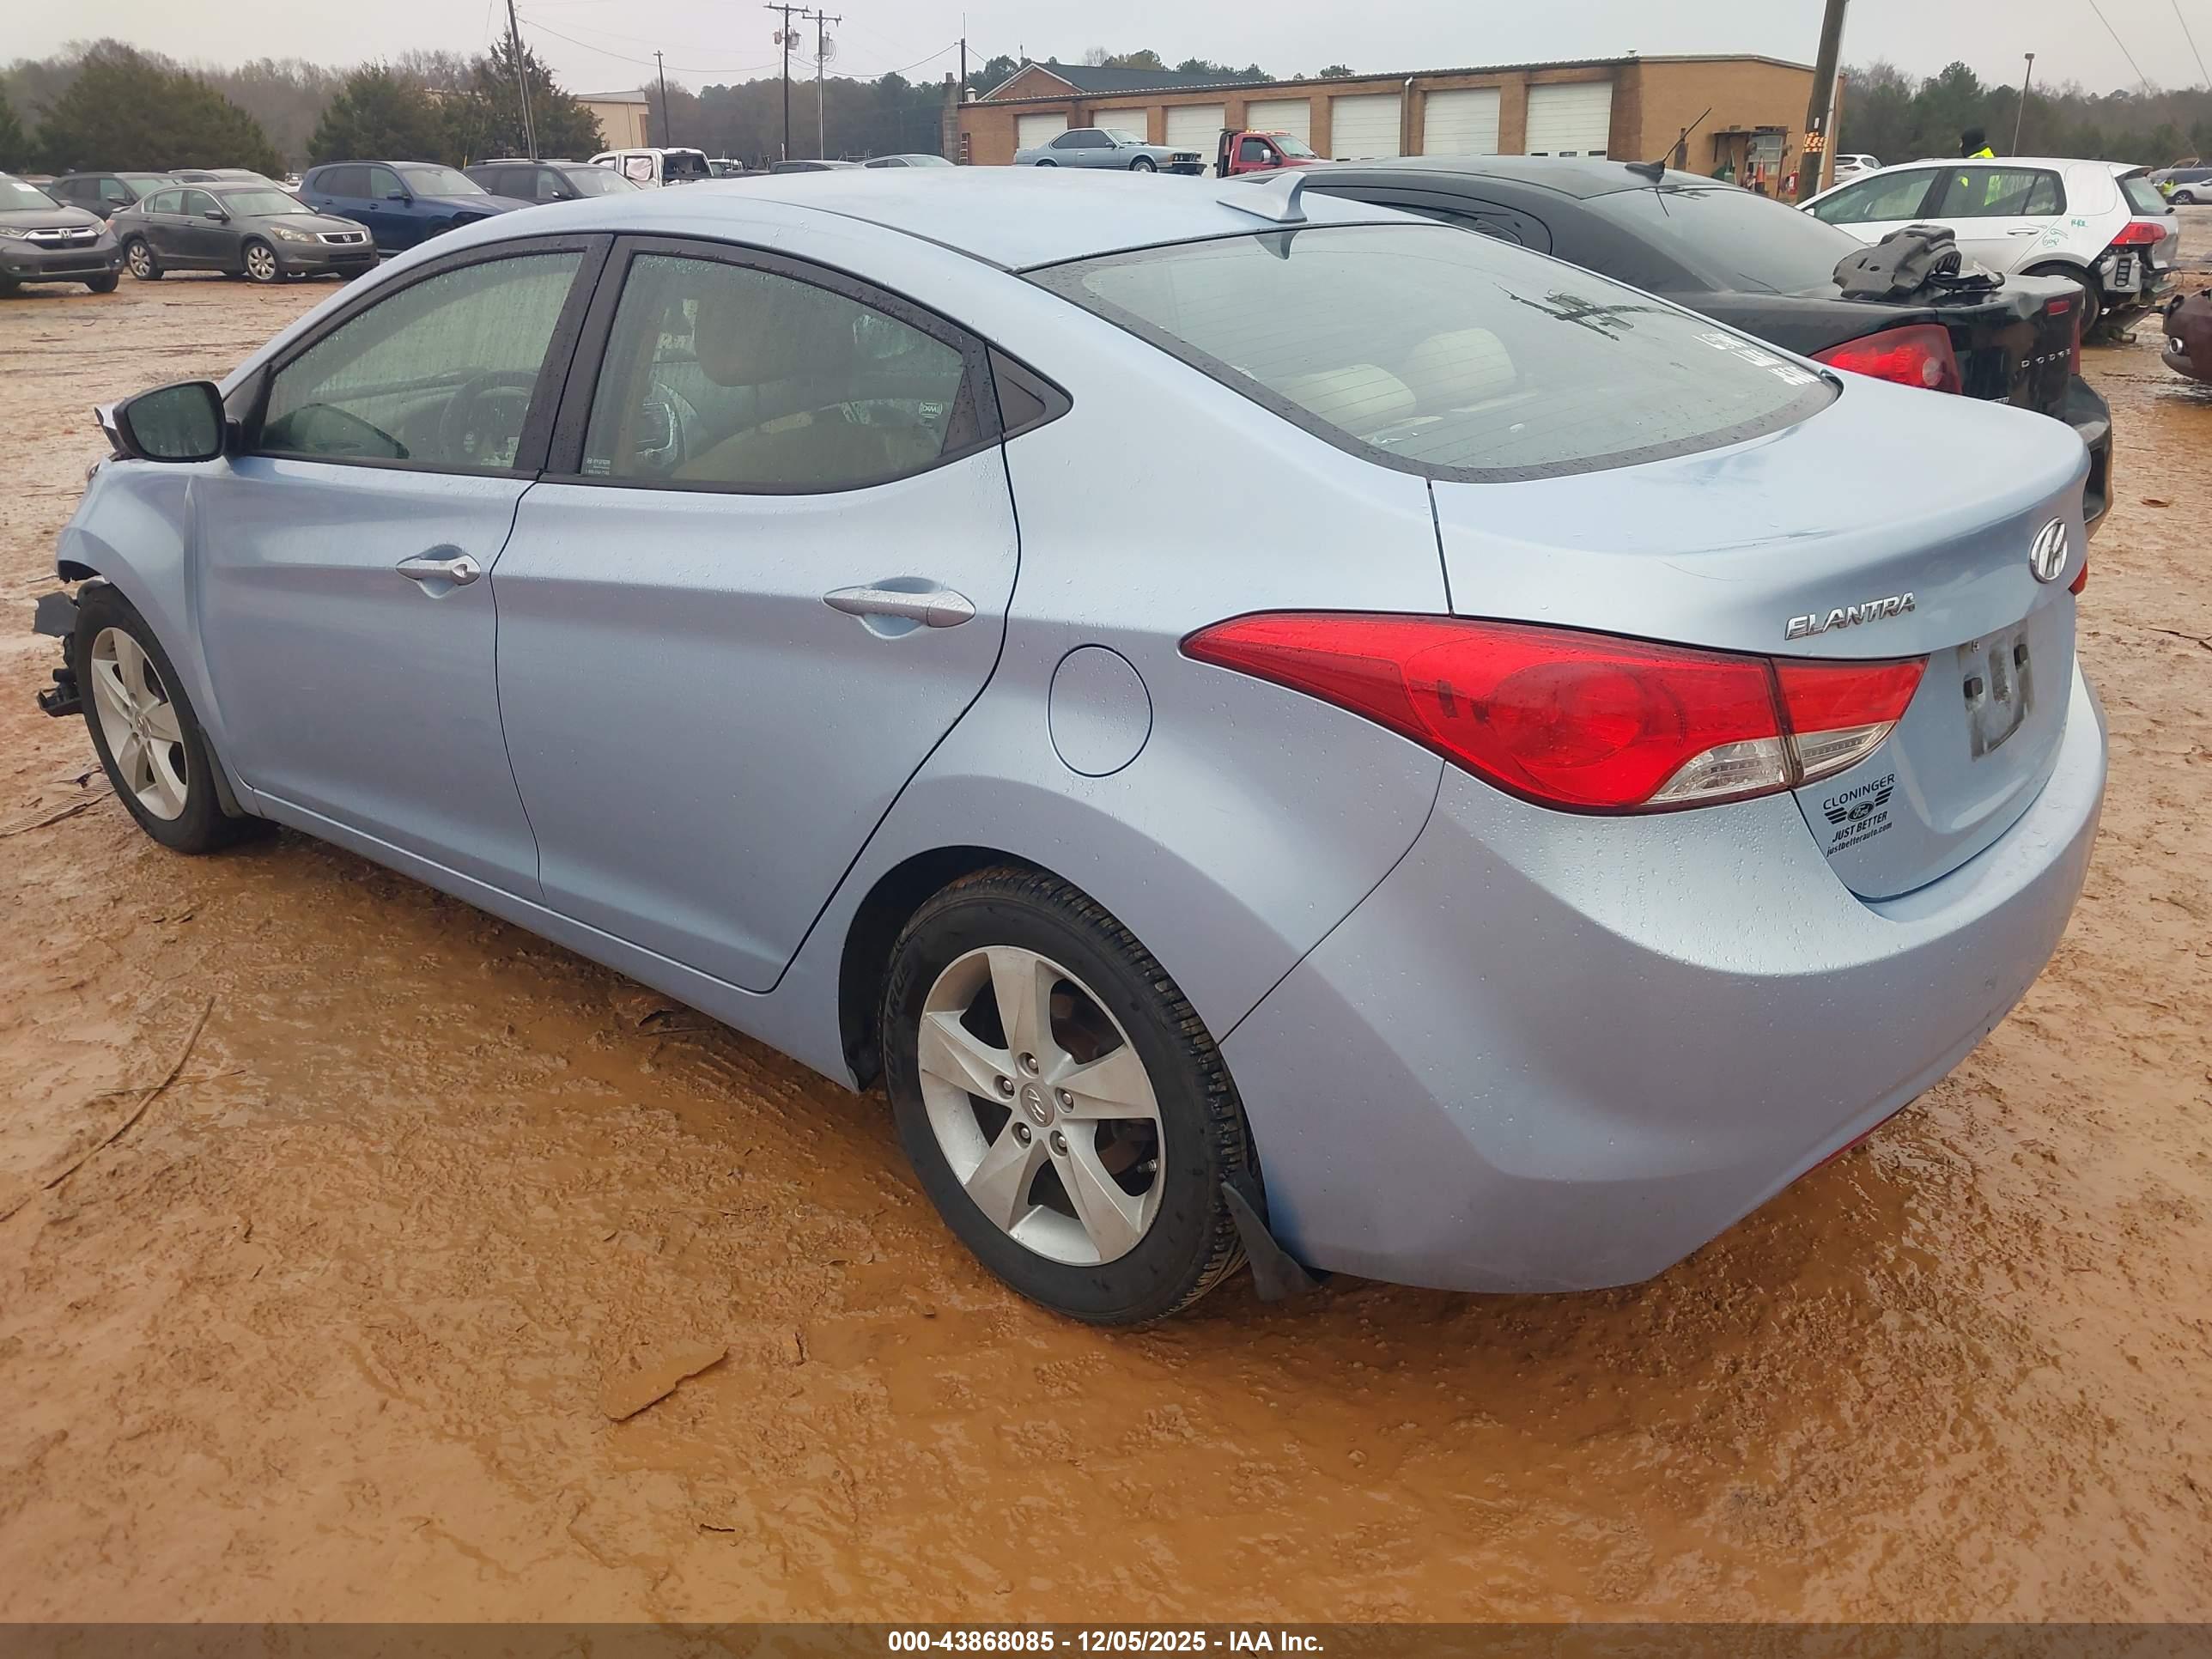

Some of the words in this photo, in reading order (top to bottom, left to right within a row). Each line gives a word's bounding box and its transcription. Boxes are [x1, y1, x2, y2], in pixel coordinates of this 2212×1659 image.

[2021, 348, 2072, 368] DODGE
[1784, 592, 1916, 641] ELANTRA
[1822, 773, 1895, 810] CLONINGER
[1826, 821, 1893, 858] justbetterauto.com
[1832, 824, 1856, 843] JUST
[1856, 811, 1888, 833] BETTER
